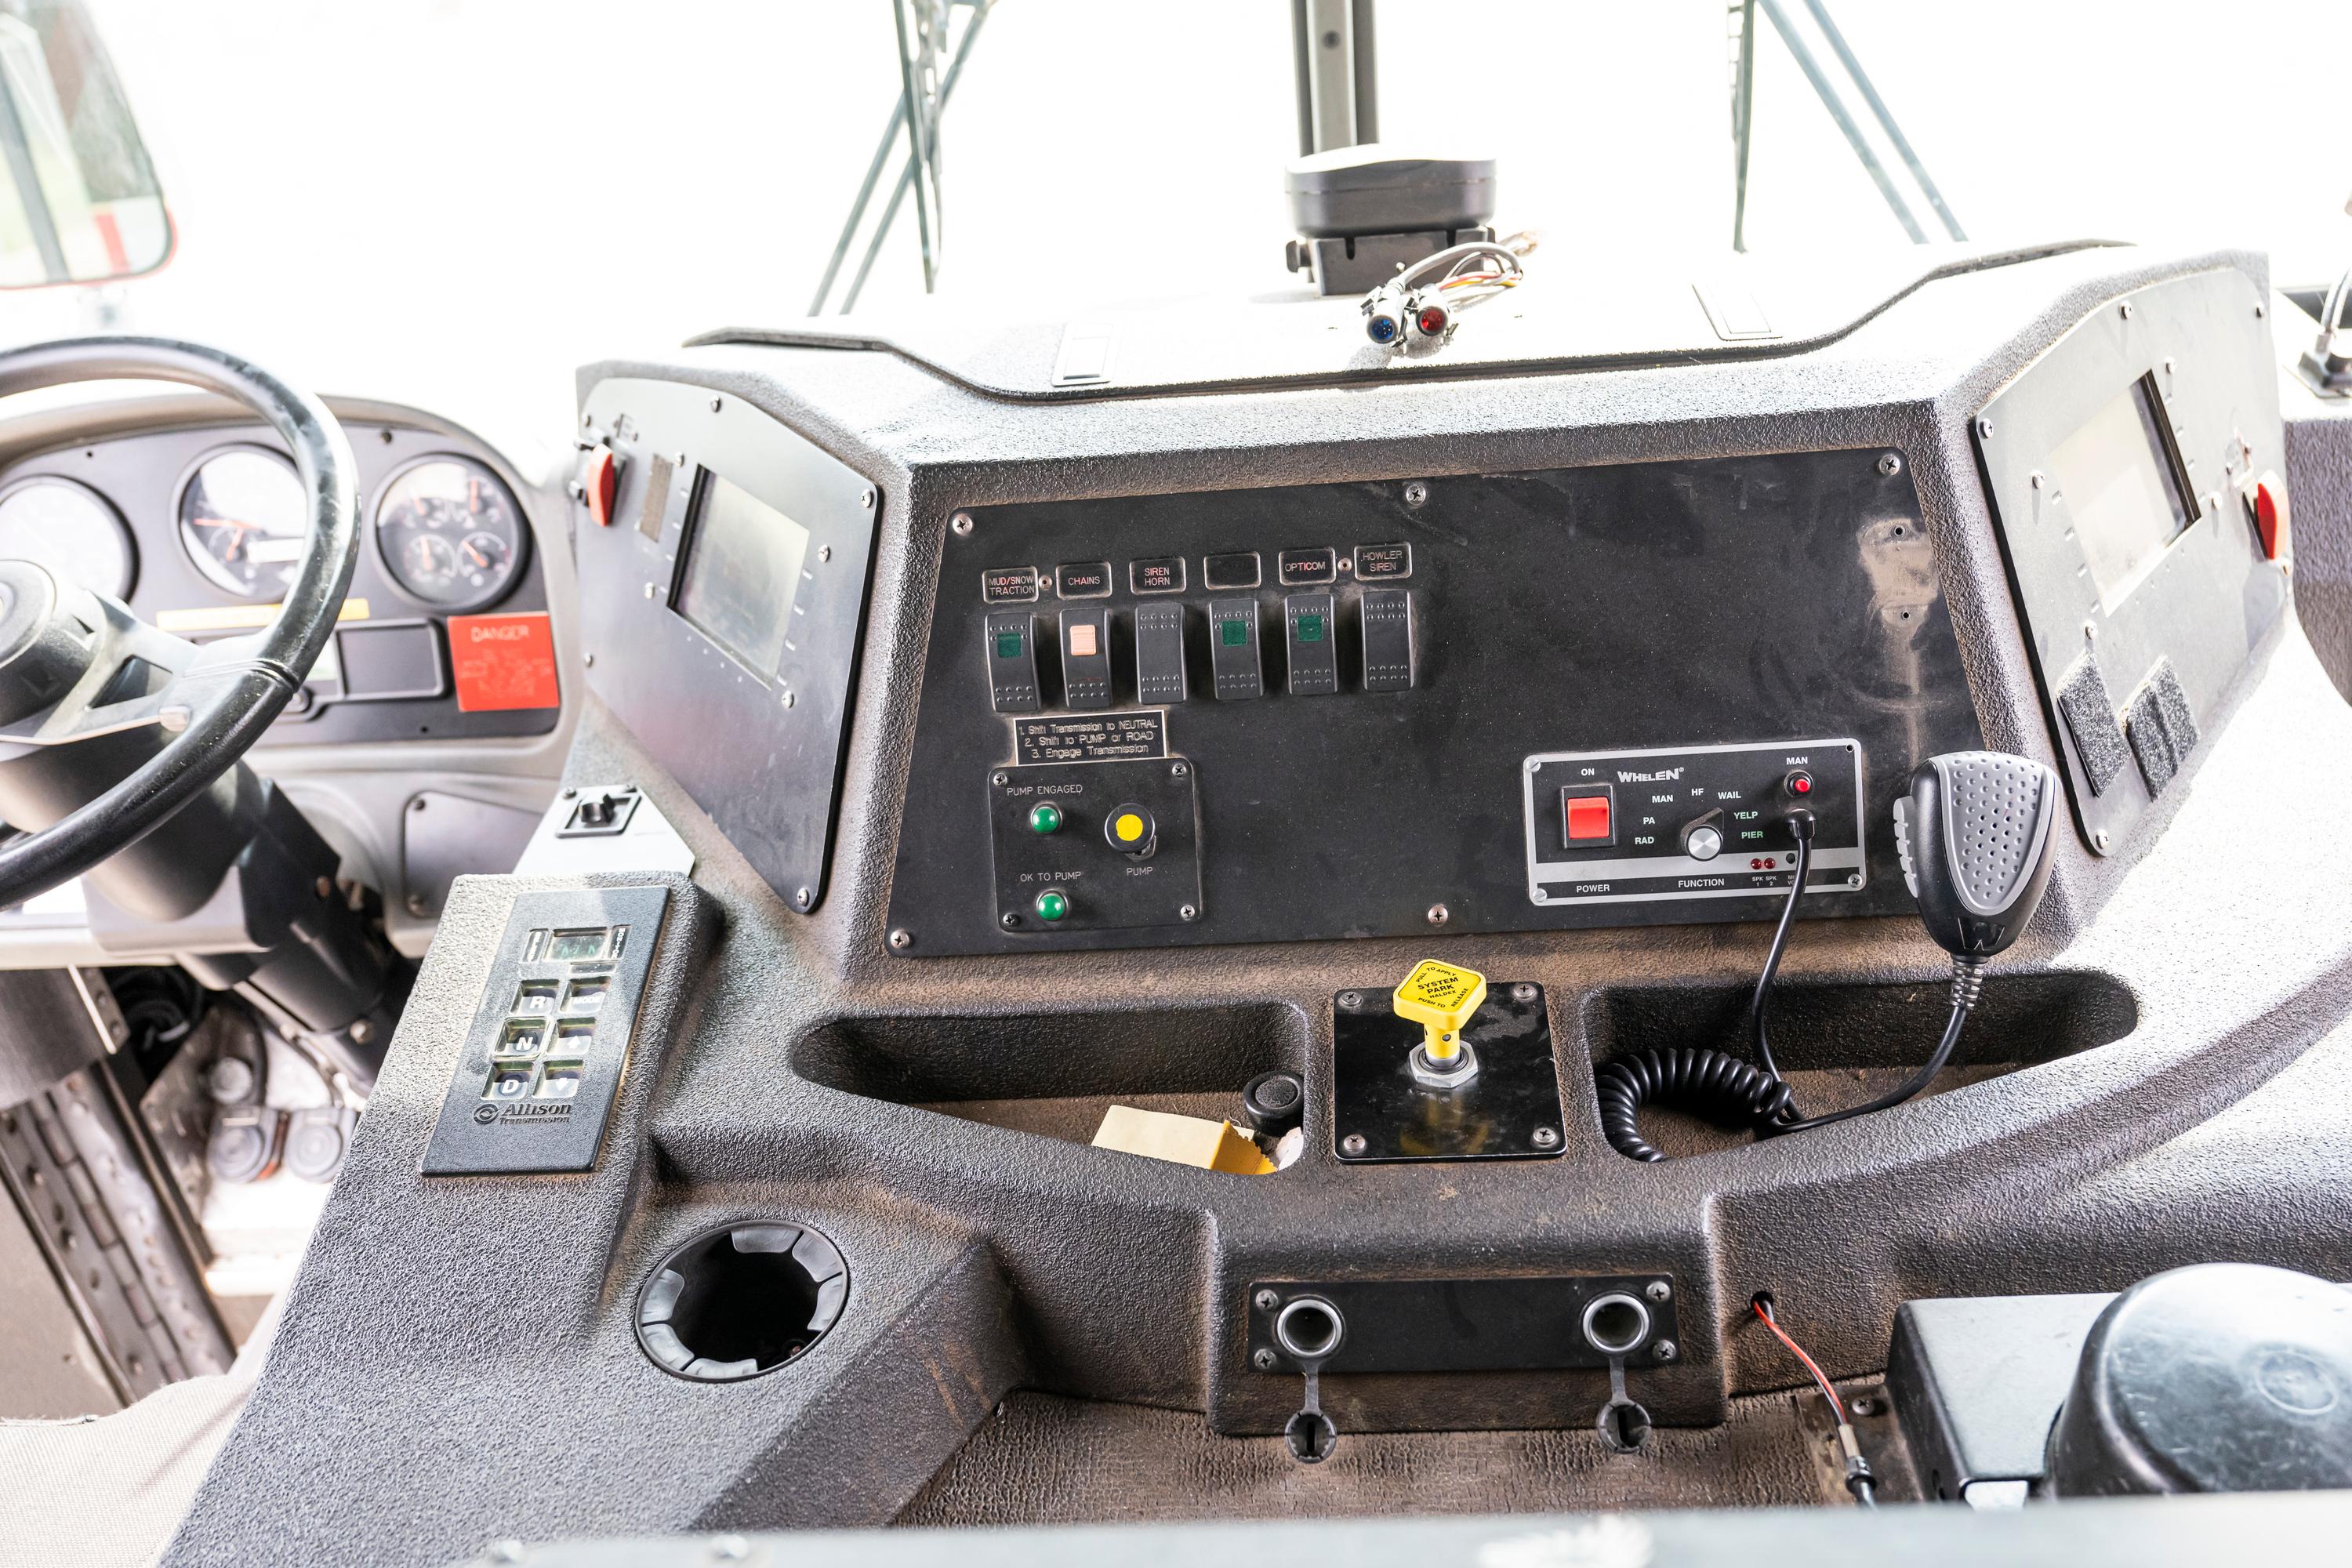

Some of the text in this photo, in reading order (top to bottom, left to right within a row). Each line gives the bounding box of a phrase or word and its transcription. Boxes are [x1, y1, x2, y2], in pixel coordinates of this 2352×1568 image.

[1362, 550, 1403, 561] HOWLER
[1145, 567, 1170, 577] SIREN
[1284, 561, 1326, 572] OPTICOM
[1370, 561, 1397, 572] SIREN
[988, 575, 1035, 586] MUD/SNOW
[1068, 575, 1101, 586] CHAINS
[1145, 576, 1171, 586] HORN
[989, 586, 1035, 596] TRACTION
[1029, 724, 1047, 735] Shift
[1050, 722, 1103, 734] Transmission
[1106, 722, 1116, 731] to
[1118, 719, 1158, 730] NEUTRAL
[1024, 731, 1154, 747] 2. Shift to PUMP or ROAD
[1031, 744, 1149, 760] 3. Engage Transmission
[1786, 757, 1809, 765] MAN
[1581, 768, 1595, 776] ON
[1007, 784, 1083, 796] PUMP ENGAGED
[1691, 787, 1704, 797] HF
[1718, 790, 1741, 800] WAIL
[1651, 794, 1674, 804] MAN
[1642, 816, 1655, 826] PA
[1733, 811, 1759, 820] YELP
[1635, 836, 1655, 845] RAD
[1741, 830, 1763, 840] PIER
[1020, 871, 1082, 882] OK TO PUMP
[1126, 866, 1153, 876] PUMP
[1678, 877, 1725, 888] FUNCTION
[1576, 884, 1610, 894] POWER
[611, 927, 626, 960] MONITOR
[1416, 972, 1427, 982] PULL
[1436, 968, 1457, 977] APPLY
[1417, 977, 1459, 989] SYSTEM
[1426, 984, 1454, 994] PARK
[1429, 990, 1457, 999] HALDEX
[530, 996, 546, 1008] R
[1451, 988, 1469, 1007] RELEASE
[517, 1036, 532, 1051] N
[502, 1080, 518, 1093] D
[502, 1103, 572, 1116] Allison
[499, 1116, 570, 1125] Transmission
